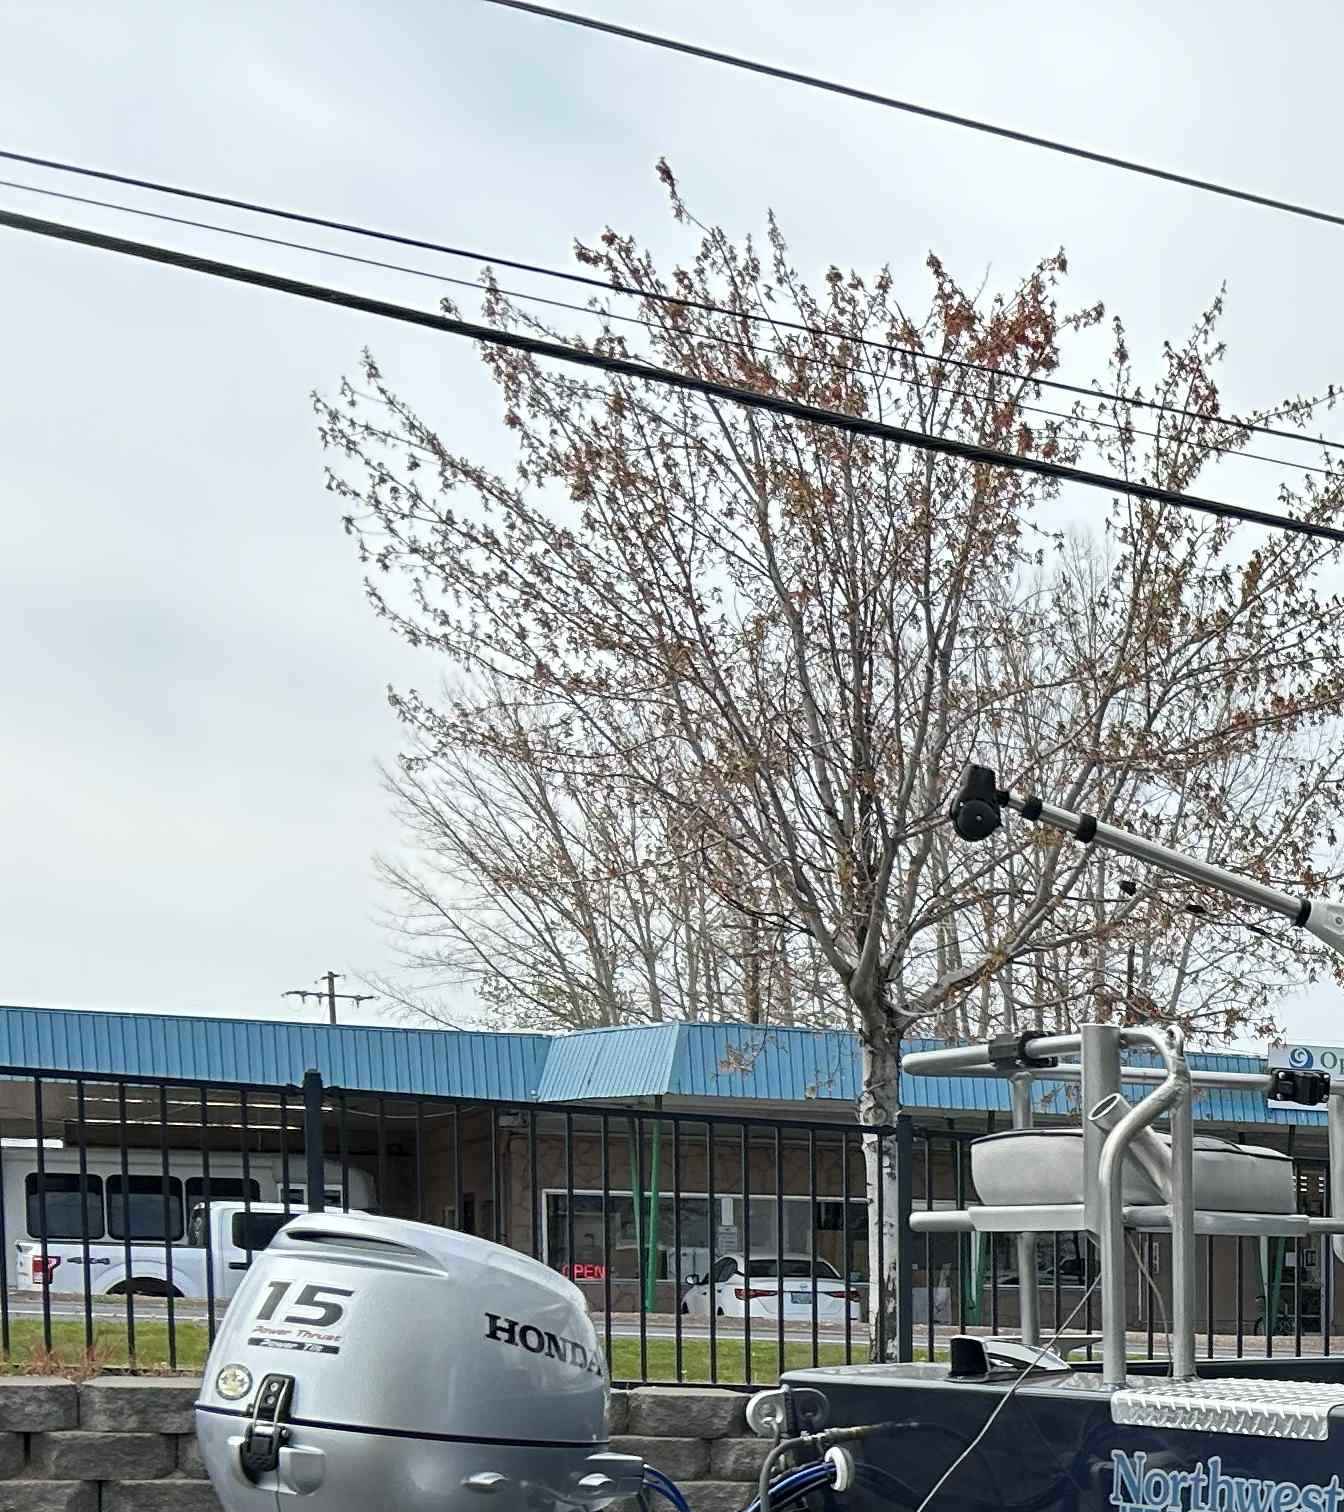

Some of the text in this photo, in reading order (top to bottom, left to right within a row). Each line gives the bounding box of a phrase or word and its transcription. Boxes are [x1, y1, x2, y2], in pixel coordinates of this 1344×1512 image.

[256, 1280, 355, 1327] 15
[297, 1329, 344, 1342] Thrust
[484, 1312, 603, 1377] HONDA
